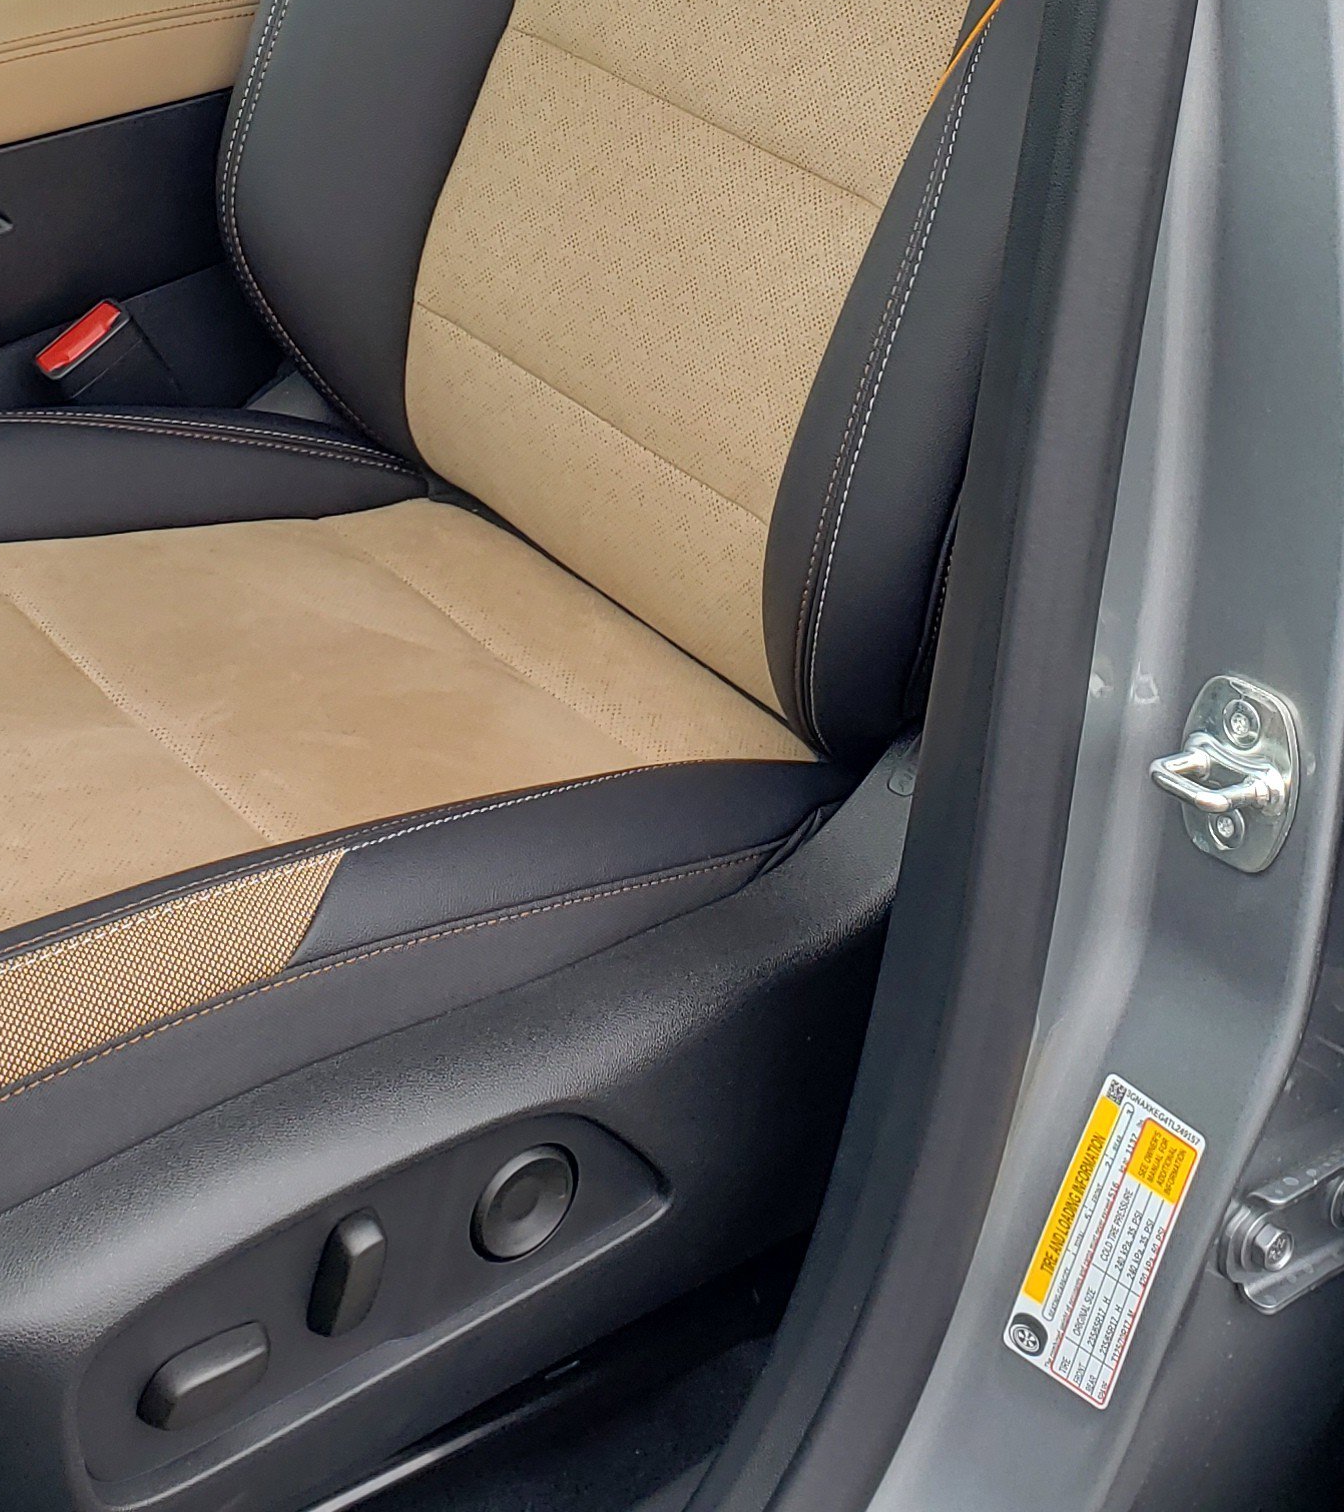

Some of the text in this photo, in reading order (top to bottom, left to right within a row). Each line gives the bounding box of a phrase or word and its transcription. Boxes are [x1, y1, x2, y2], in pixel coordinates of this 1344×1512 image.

[1070, 1130, 1106, 1197] INFORMATION
[1055, 1190, 1081, 1236] LOADING
[1130, 1208, 1143, 1227] PSI
[1142, 1216, 1155, 1235] PSI
[1047, 1230, 1066, 1256] AND
[1098, 1239, 1114, 1263] COLD
[1039, 1250, 1058, 1276] TIRE
